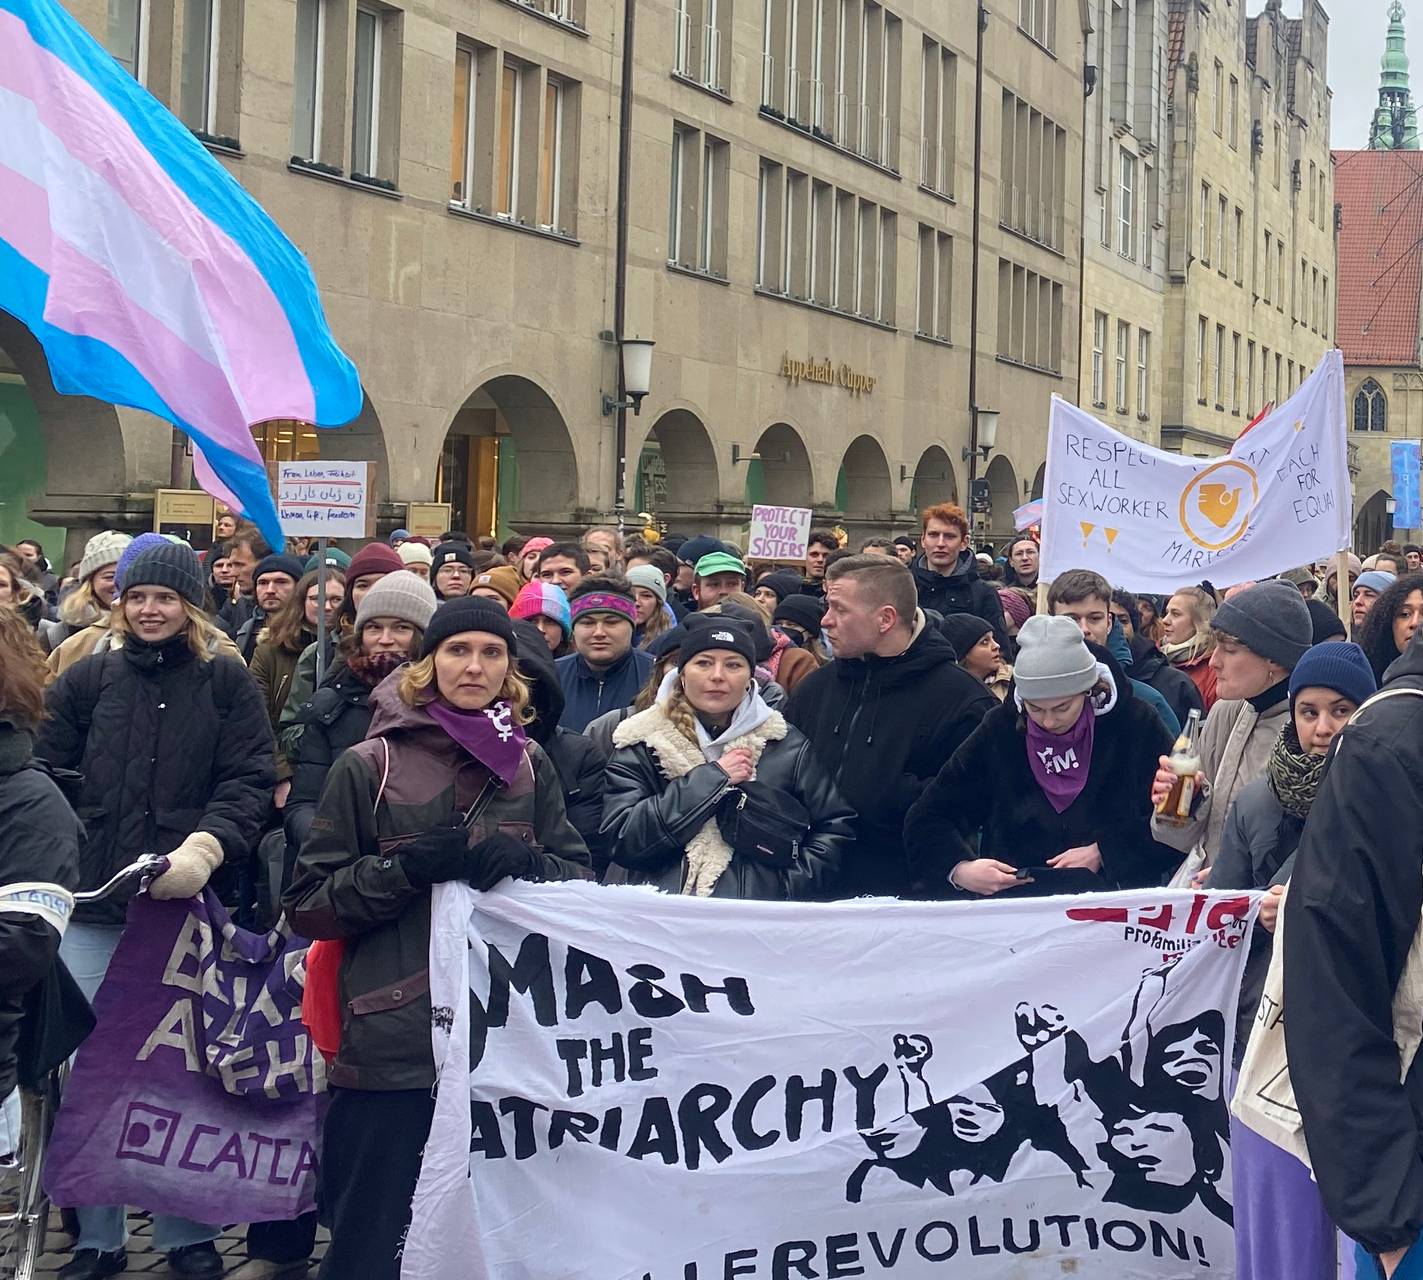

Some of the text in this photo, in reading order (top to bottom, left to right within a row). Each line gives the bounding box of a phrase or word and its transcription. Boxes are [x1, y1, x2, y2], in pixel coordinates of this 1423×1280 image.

[1276, 443, 1320, 482] EACH
[1089, 468, 1126, 489] ALL
[1297, 468, 1321, 492] FOR
[1057, 482, 1169, 519] SEXWORKER
[753, 507, 809, 527] PROTECT
[750, 537, 806, 558] SISTERS
[764, 524, 798, 541] YOUR
[556, 1027, 659, 1098] THE
[468, 1062, 889, 1170] ATRIARCHY
[772, 1214, 1211, 1280] REVOLUTION!
